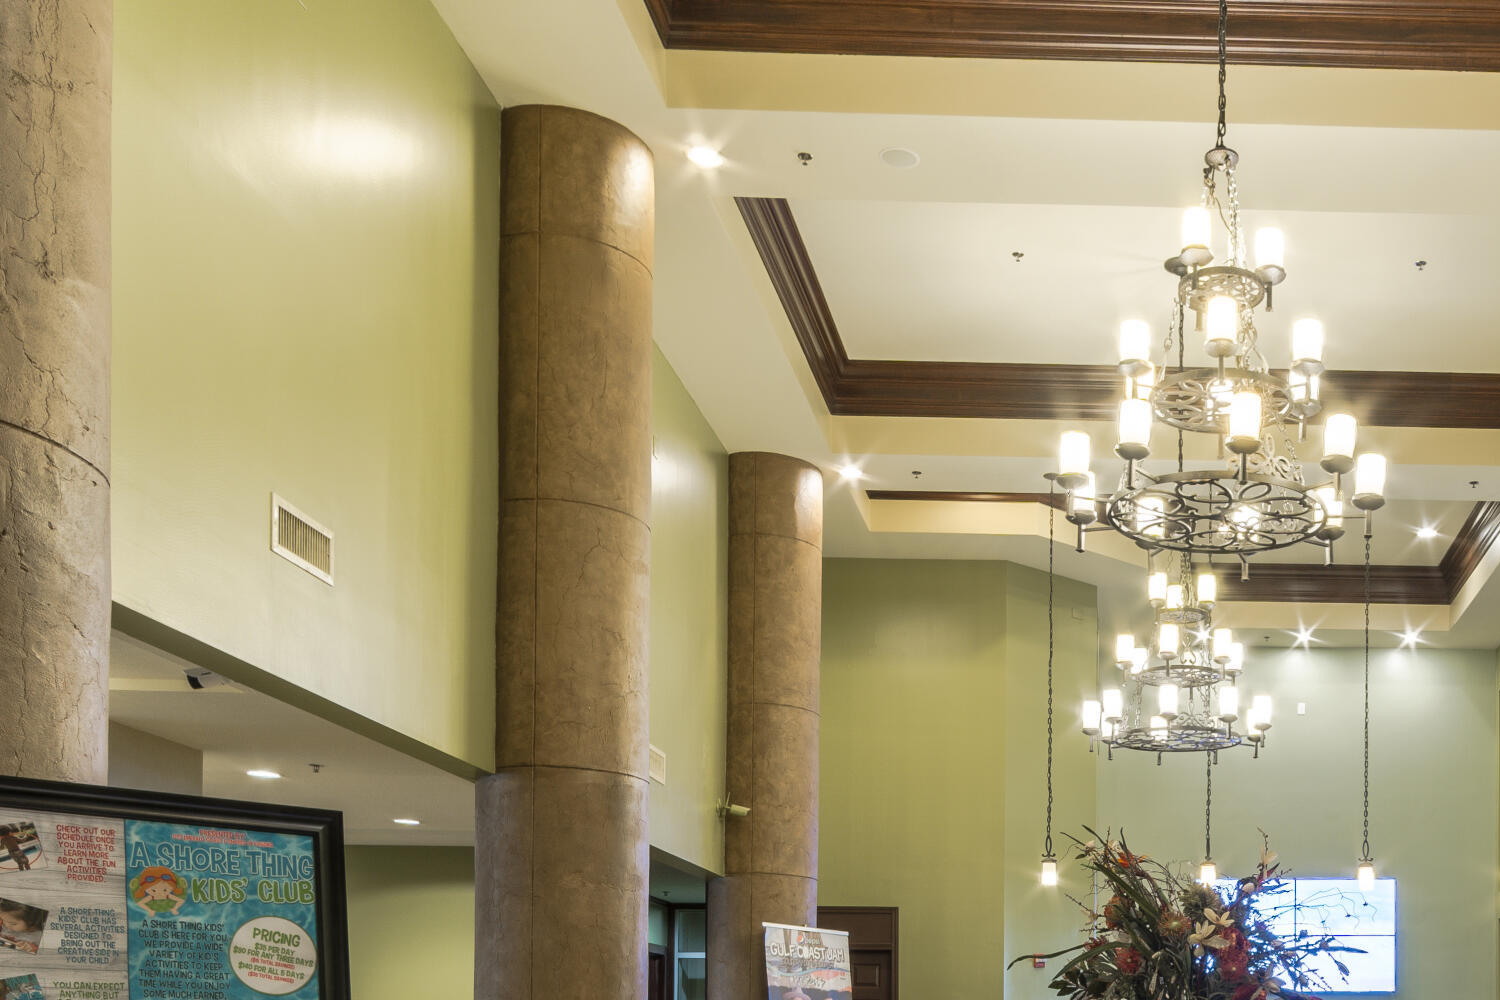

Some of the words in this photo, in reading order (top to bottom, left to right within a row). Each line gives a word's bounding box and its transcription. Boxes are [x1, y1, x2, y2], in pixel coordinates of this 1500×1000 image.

[56, 824, 80, 833] CHECK
[57, 833, 95, 842] SCHEDULE
[130, 841, 150, 868] A
[156, 842, 241, 876] SHORE
[246, 850, 314, 881] THING
[67, 865, 106, 875] ACTIVITIES
[190, 877, 248, 903] KIDS'
[258, 880, 315, 904] CLUB
[51, 922, 83, 931] SEVERAL
[85, 925, 125, 933] ACTIVITIES
[150, 920, 177, 929] SHORE
[179, 921, 202, 930] THING
[205, 924, 224, 932] KIDS'
[64, 931, 99, 940] DESIGNED
[253, 928, 301, 947] PRICING
[160, 941, 194, 949] PROVIDE
[204, 943, 223, 951] WIDE
[770, 943, 795, 956] GULF
[797, 946, 825, 960] COAST
[145, 960, 189, 969] ACTIVITIES
[276, 954, 294, 964] THREE
[296, 958, 313, 967] DAYS
[163, 970, 192, 979] HAVING
[139, 979, 157, 987] TIME
[205, 982, 230, 990] ENJOY
[60, 990, 100, 999] ANYTHING
[144, 990, 166, 998] SOME
